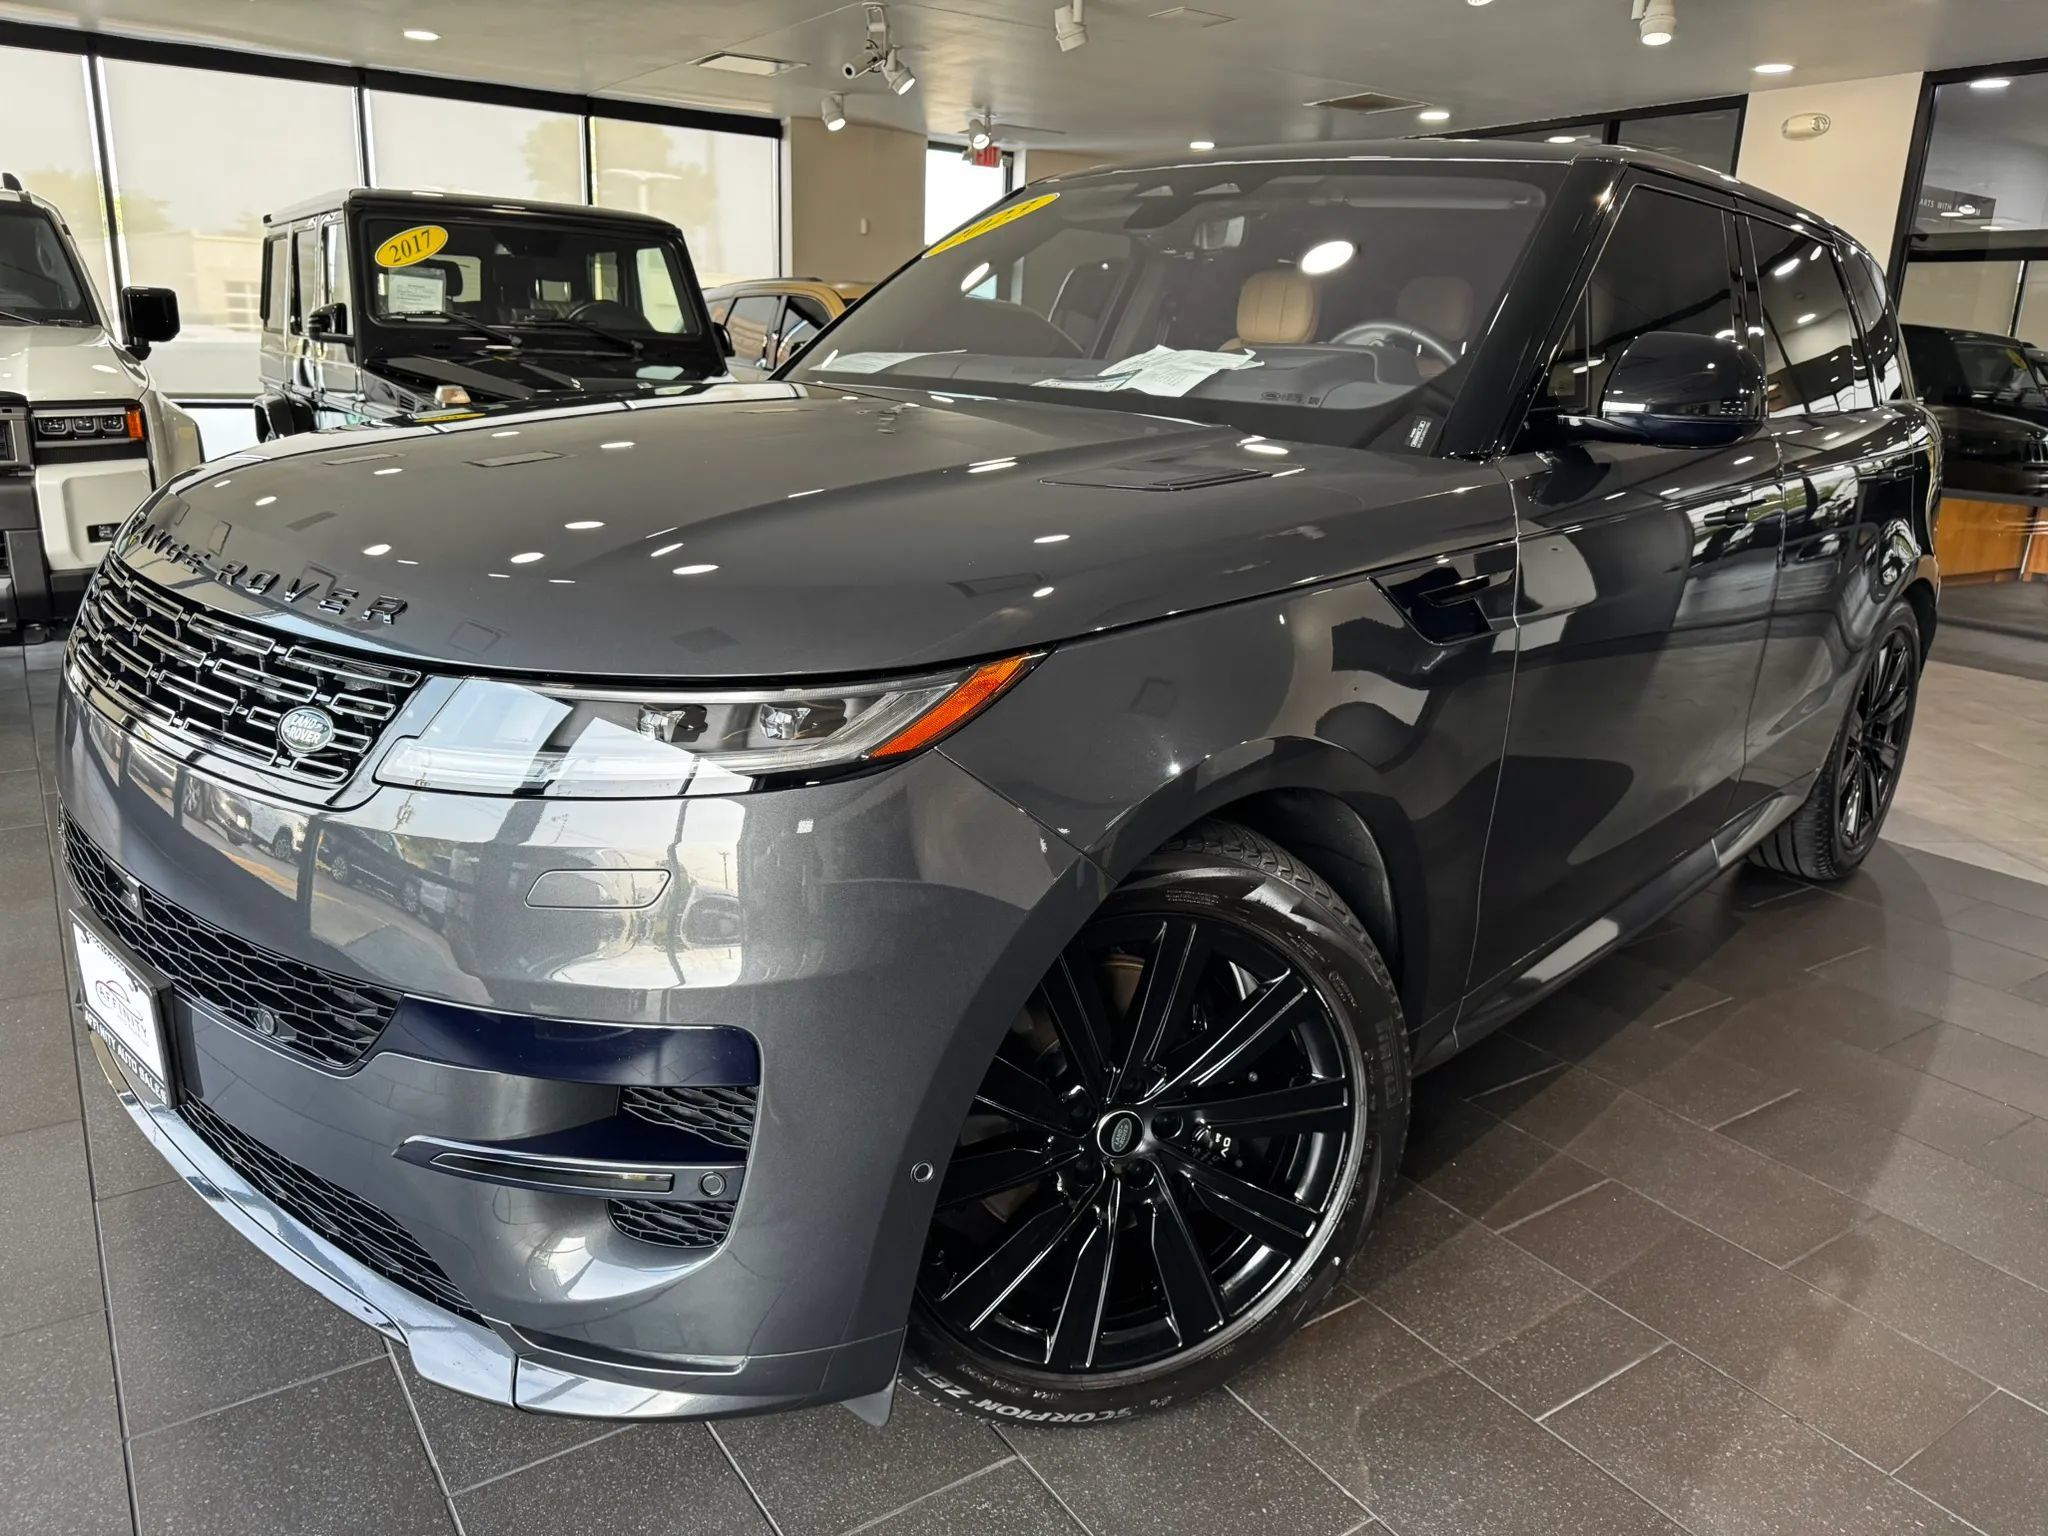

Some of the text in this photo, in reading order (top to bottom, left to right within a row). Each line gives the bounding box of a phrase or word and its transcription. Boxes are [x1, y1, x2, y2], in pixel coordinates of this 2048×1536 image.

[388, 229, 431, 264] 2017
[214, 558, 408, 625] ROVER
[291, 713, 317, 729] LAND
[287, 726, 321, 744] ROVER
[117, 1044, 138, 1074] AUTO
[138, 1066, 168, 1106] SALES
[1119, 1123, 1129, 1144] ROVER
[974, 1398, 1132, 1423] SCORPION
